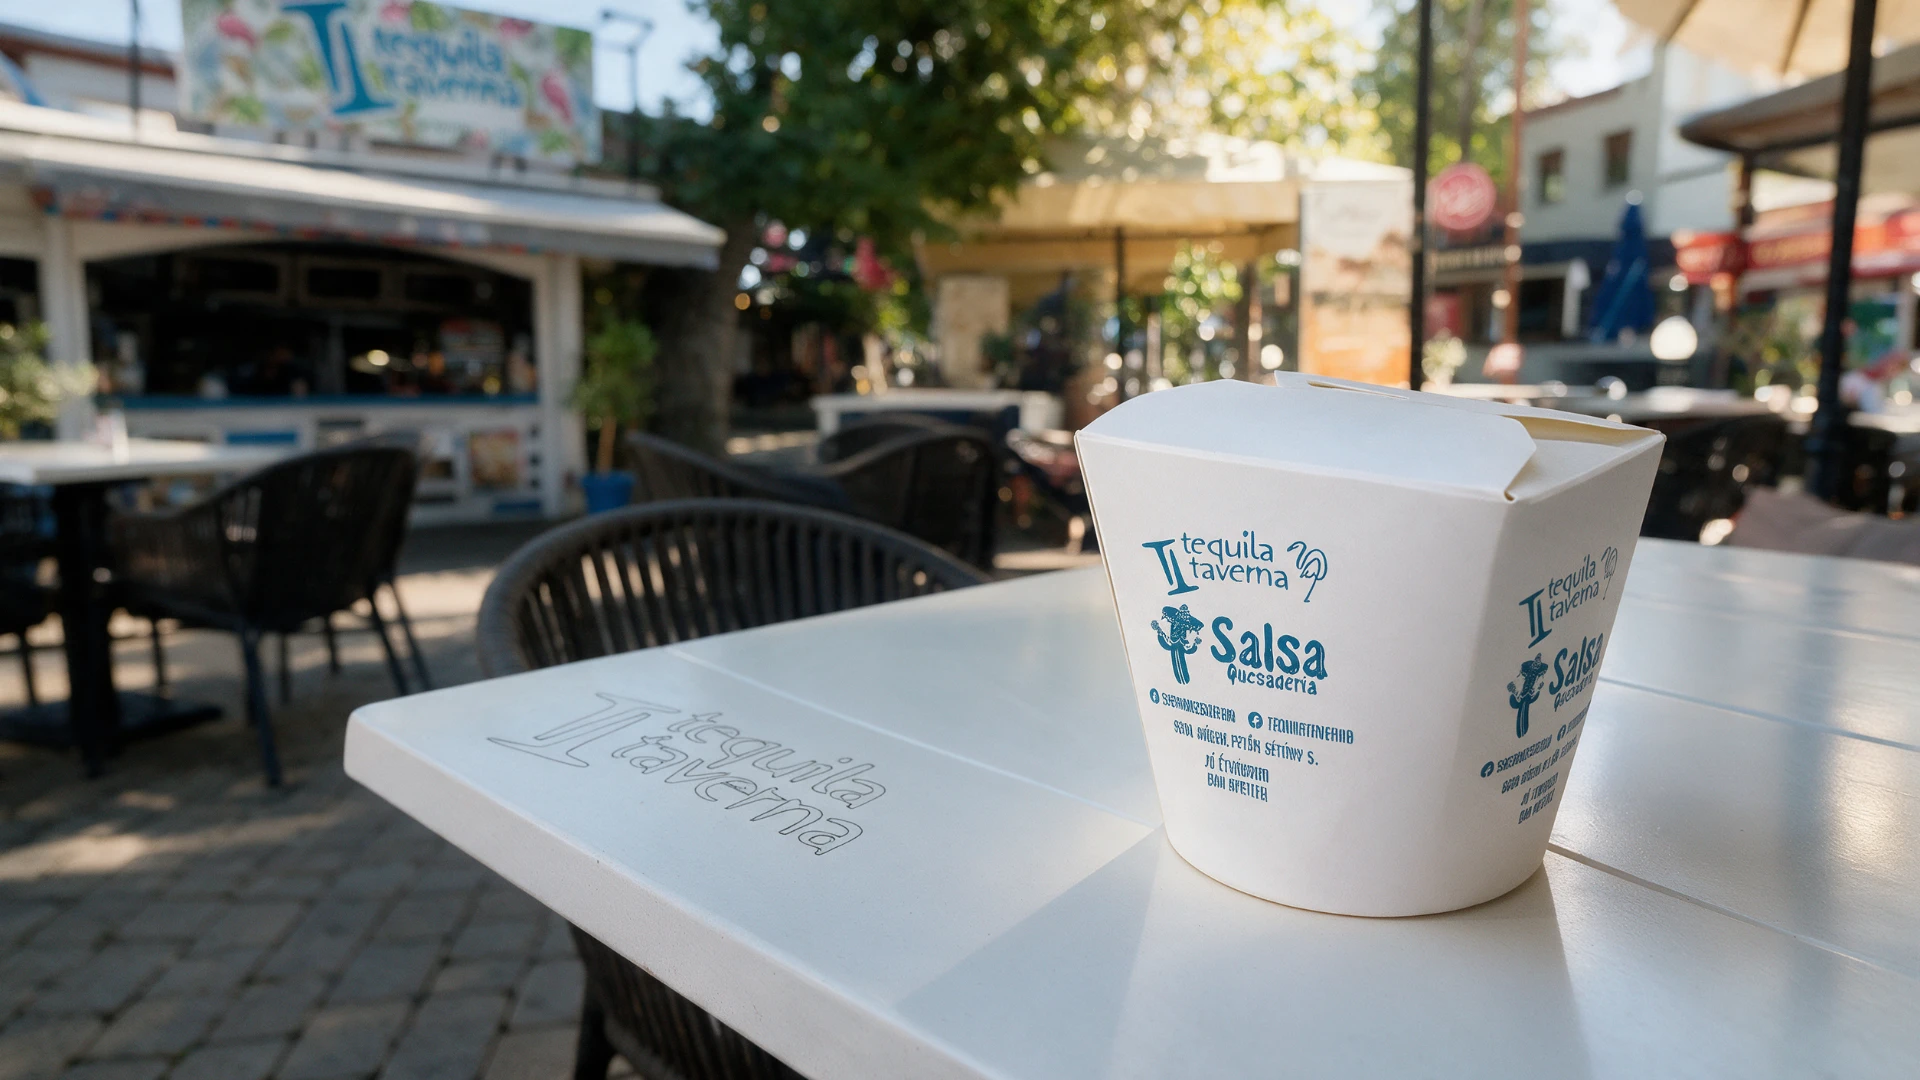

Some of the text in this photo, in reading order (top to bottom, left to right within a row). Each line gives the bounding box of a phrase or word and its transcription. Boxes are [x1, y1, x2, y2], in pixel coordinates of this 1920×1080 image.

[373, 27, 503, 72] tequila
[1180, 530, 1274, 566] tequila
[1189, 558, 1289, 590] taverna
[1548, 553, 1596, 599] tequila
[1549, 580, 1599, 622] taverna
[1210, 616, 1328, 680] Salsa
[1549, 632, 1604, 695] Salsa
[665, 712, 887, 809] tequila
[611, 735, 863, 856] taverna
